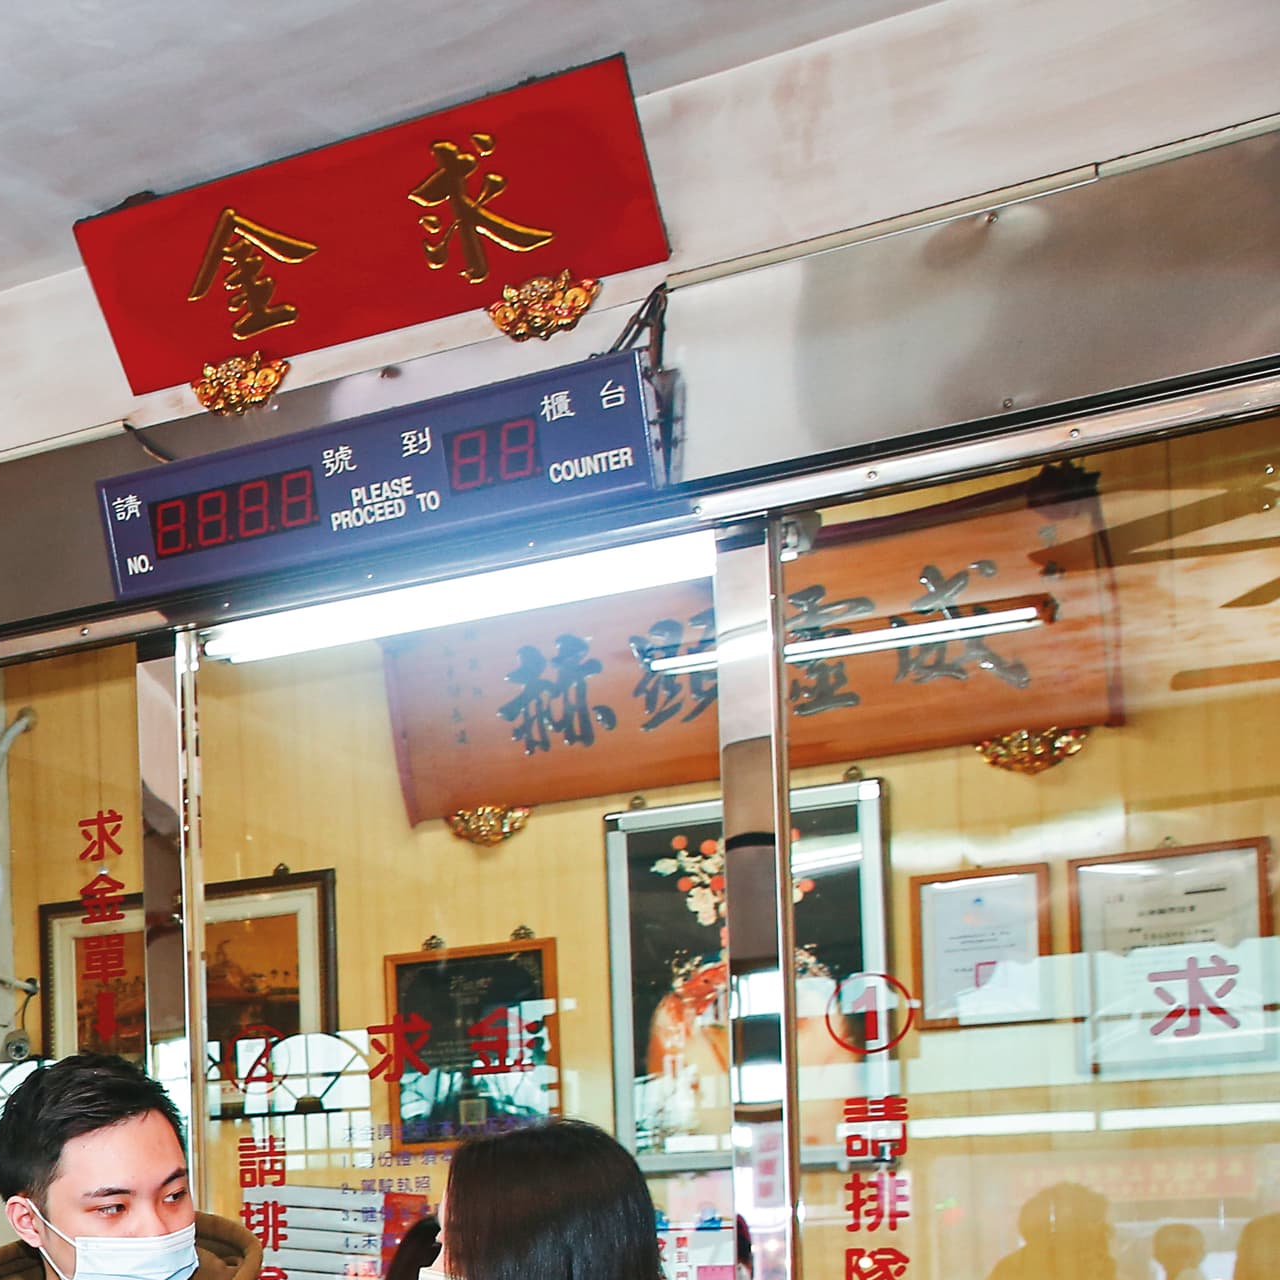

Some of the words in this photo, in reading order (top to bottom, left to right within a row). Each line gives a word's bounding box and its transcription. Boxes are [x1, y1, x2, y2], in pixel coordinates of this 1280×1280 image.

[112, 494, 143, 522] 請
[127, 554, 154, 576] NO.
[351, 476, 414, 508] PLEASE
[549, 447, 634, 484] COUNTER
[330, 498, 407, 531] PROCEED
[416, 490, 441, 513] TO
[77, 809, 127, 983] 求金單
[1147, 955, 1241, 1037] 求
[367, 1007, 537, 1083] 求金
